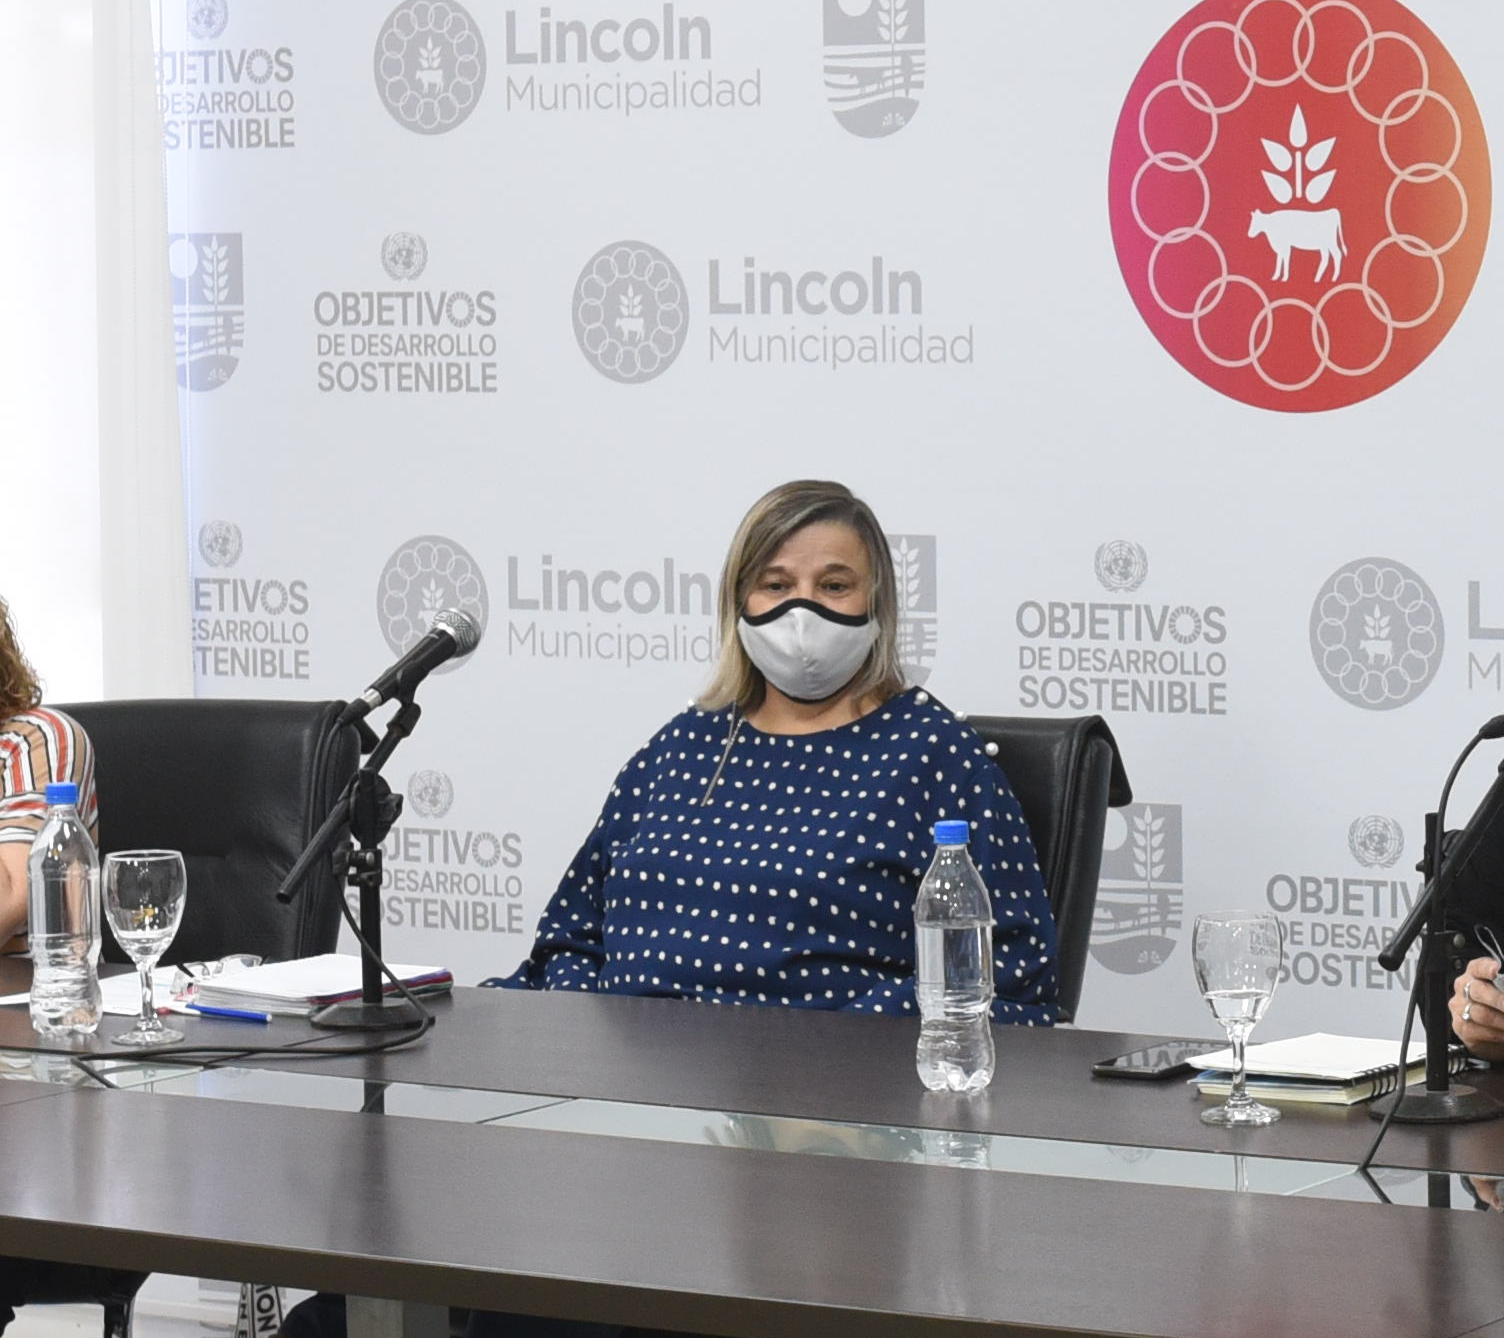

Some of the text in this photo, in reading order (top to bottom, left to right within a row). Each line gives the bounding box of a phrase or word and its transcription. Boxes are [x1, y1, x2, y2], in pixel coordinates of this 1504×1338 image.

[506, 3, 711, 65] Lincoln
[507, 69, 760, 117] Municipalidad
[709, 256, 922, 315] Lincoln
[314, 291, 496, 327] OBJETIVOS
[318, 334, 496, 356] DE DESARROLLO
[710, 325, 973, 371] Municipalidad
[318, 361, 497, 393] SOSTENIBLE
[507, 554, 713, 618] Lincoln
[507, 621, 715, 668] Municipalid
[1016, 601, 1226, 644] OBJETIVOS
[1020, 646, 1226, 676] DE DESARROLLO
[1019, 675, 1226, 715] SOSTENIBLE
